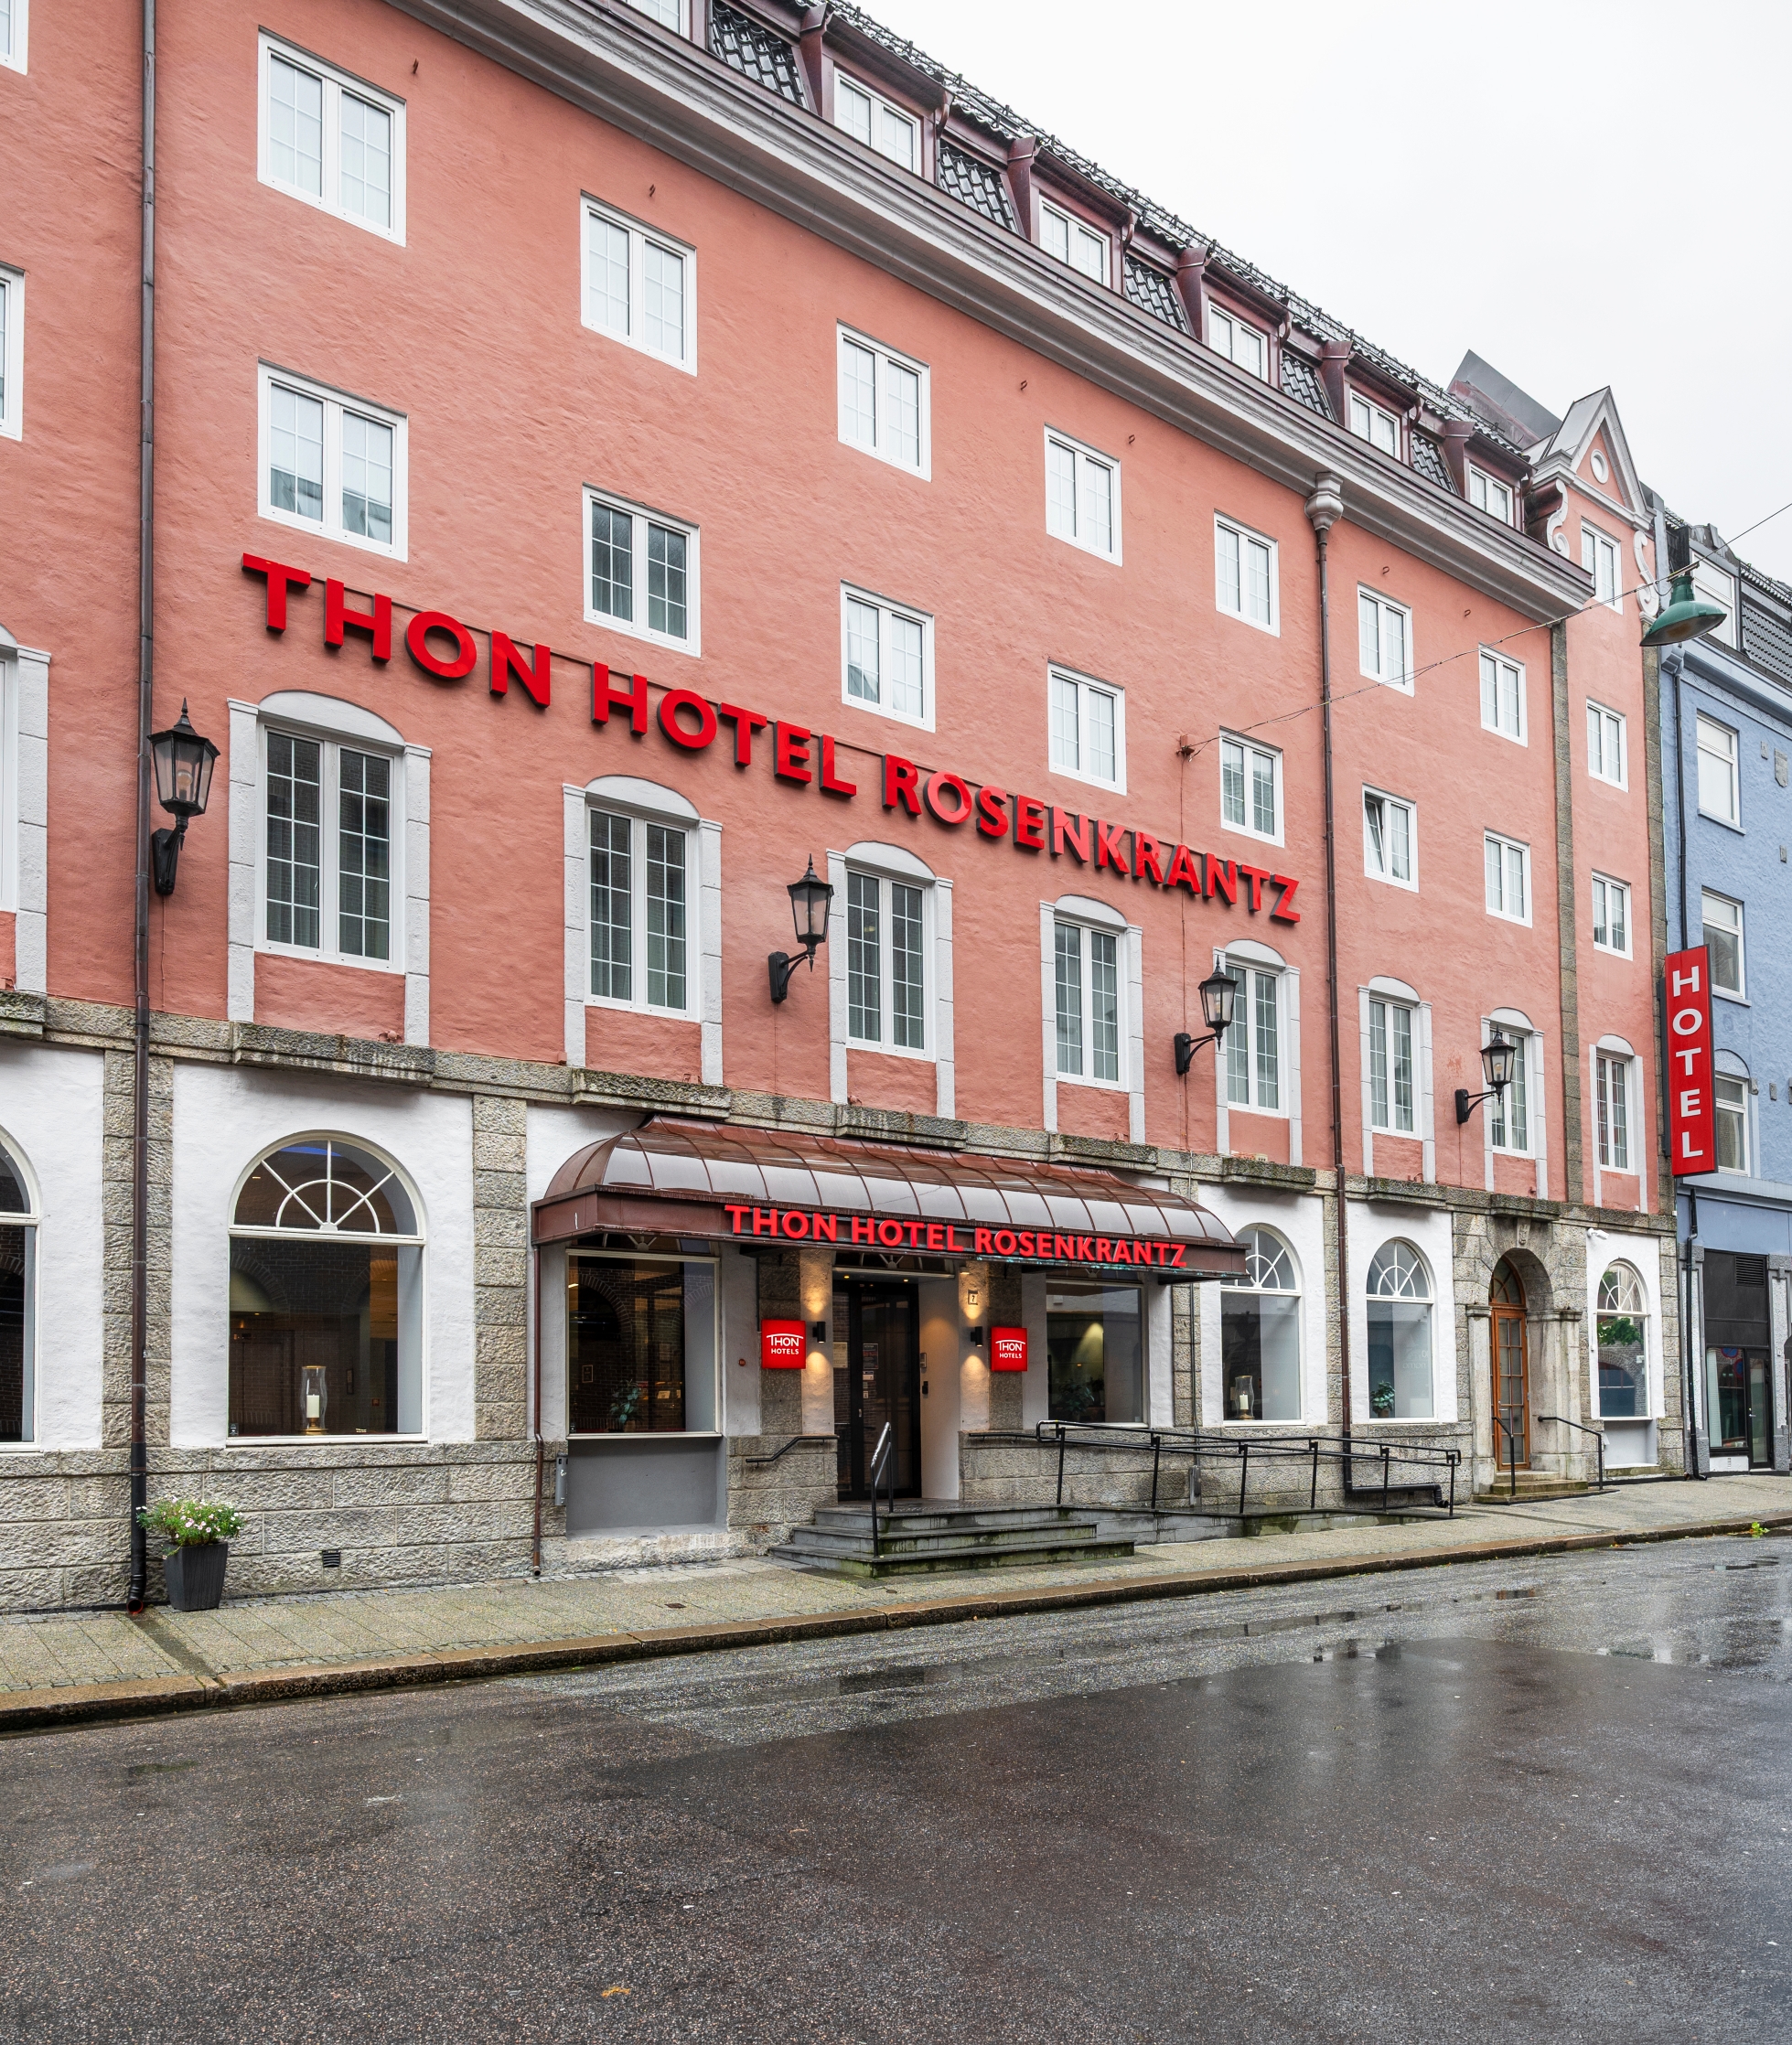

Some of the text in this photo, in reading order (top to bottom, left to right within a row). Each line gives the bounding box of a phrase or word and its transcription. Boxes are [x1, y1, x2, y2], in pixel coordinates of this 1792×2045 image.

[241, 552, 1301, 924] THON HOTEL ROSENKRANTZ
[1672, 965, 1703, 1159] HOTEL
[724, 1205, 1186, 1268] THON HOTEL ROSENKRANTZ
[767, 1333, 804, 1347] THON
[995, 1339, 1026, 1352] THON
